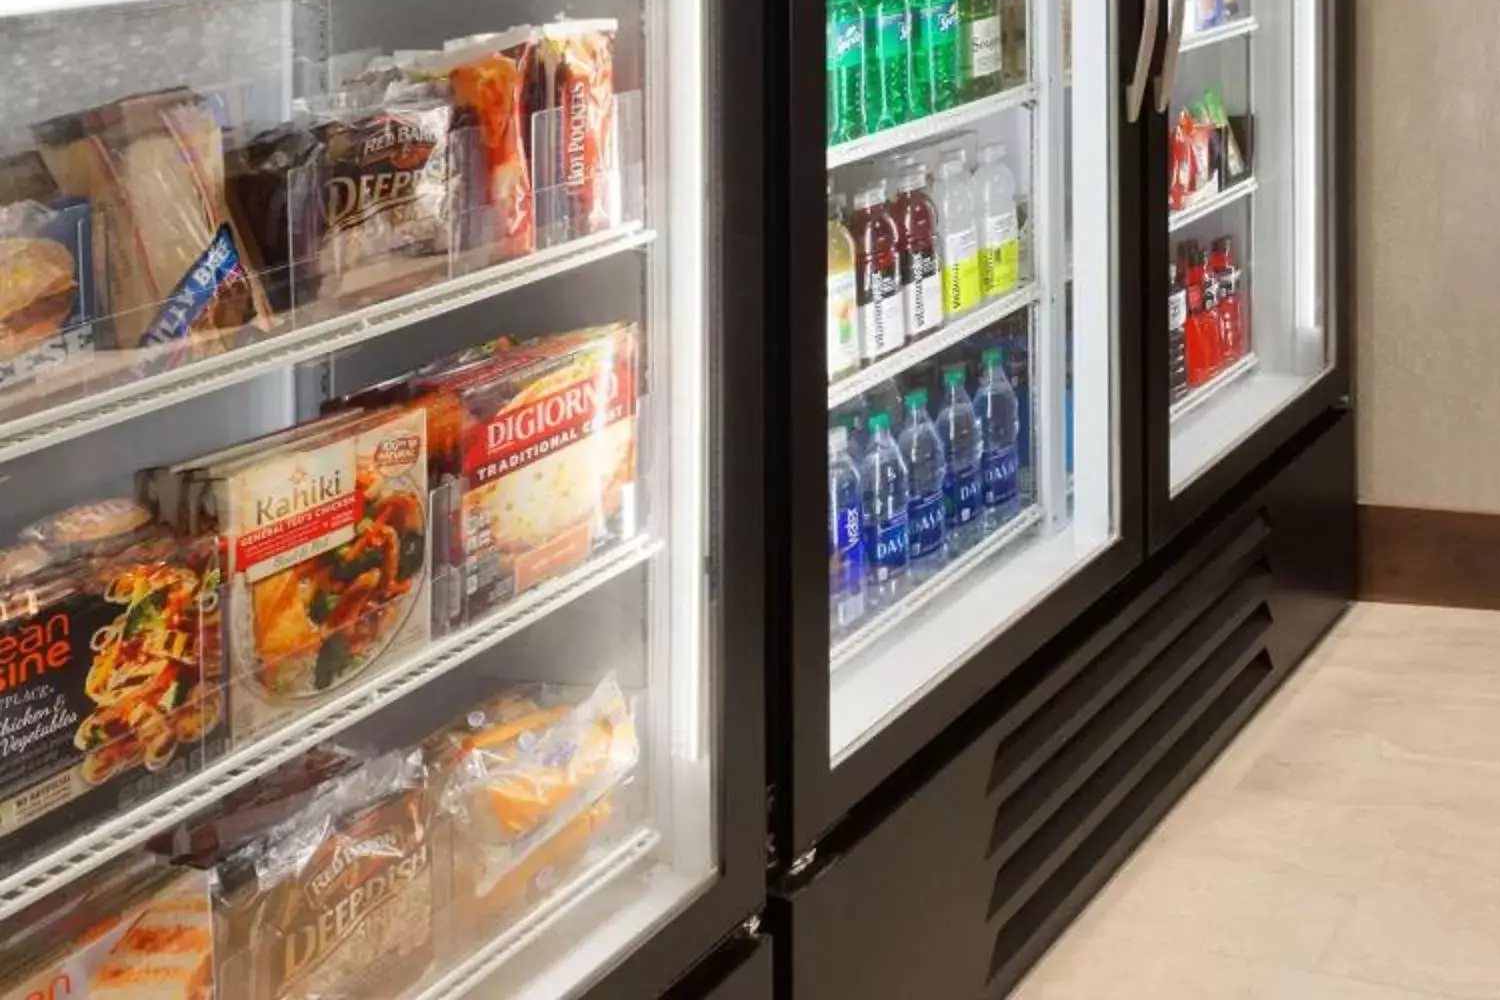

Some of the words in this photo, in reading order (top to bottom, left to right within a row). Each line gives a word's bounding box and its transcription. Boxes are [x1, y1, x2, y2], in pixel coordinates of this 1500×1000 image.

[477, 430, 578, 482] TRADITIONAL
[256, 470, 342, 526] Kahiki
[0, 614, 70, 664] ean
[0, 702, 52, 738] hicken
